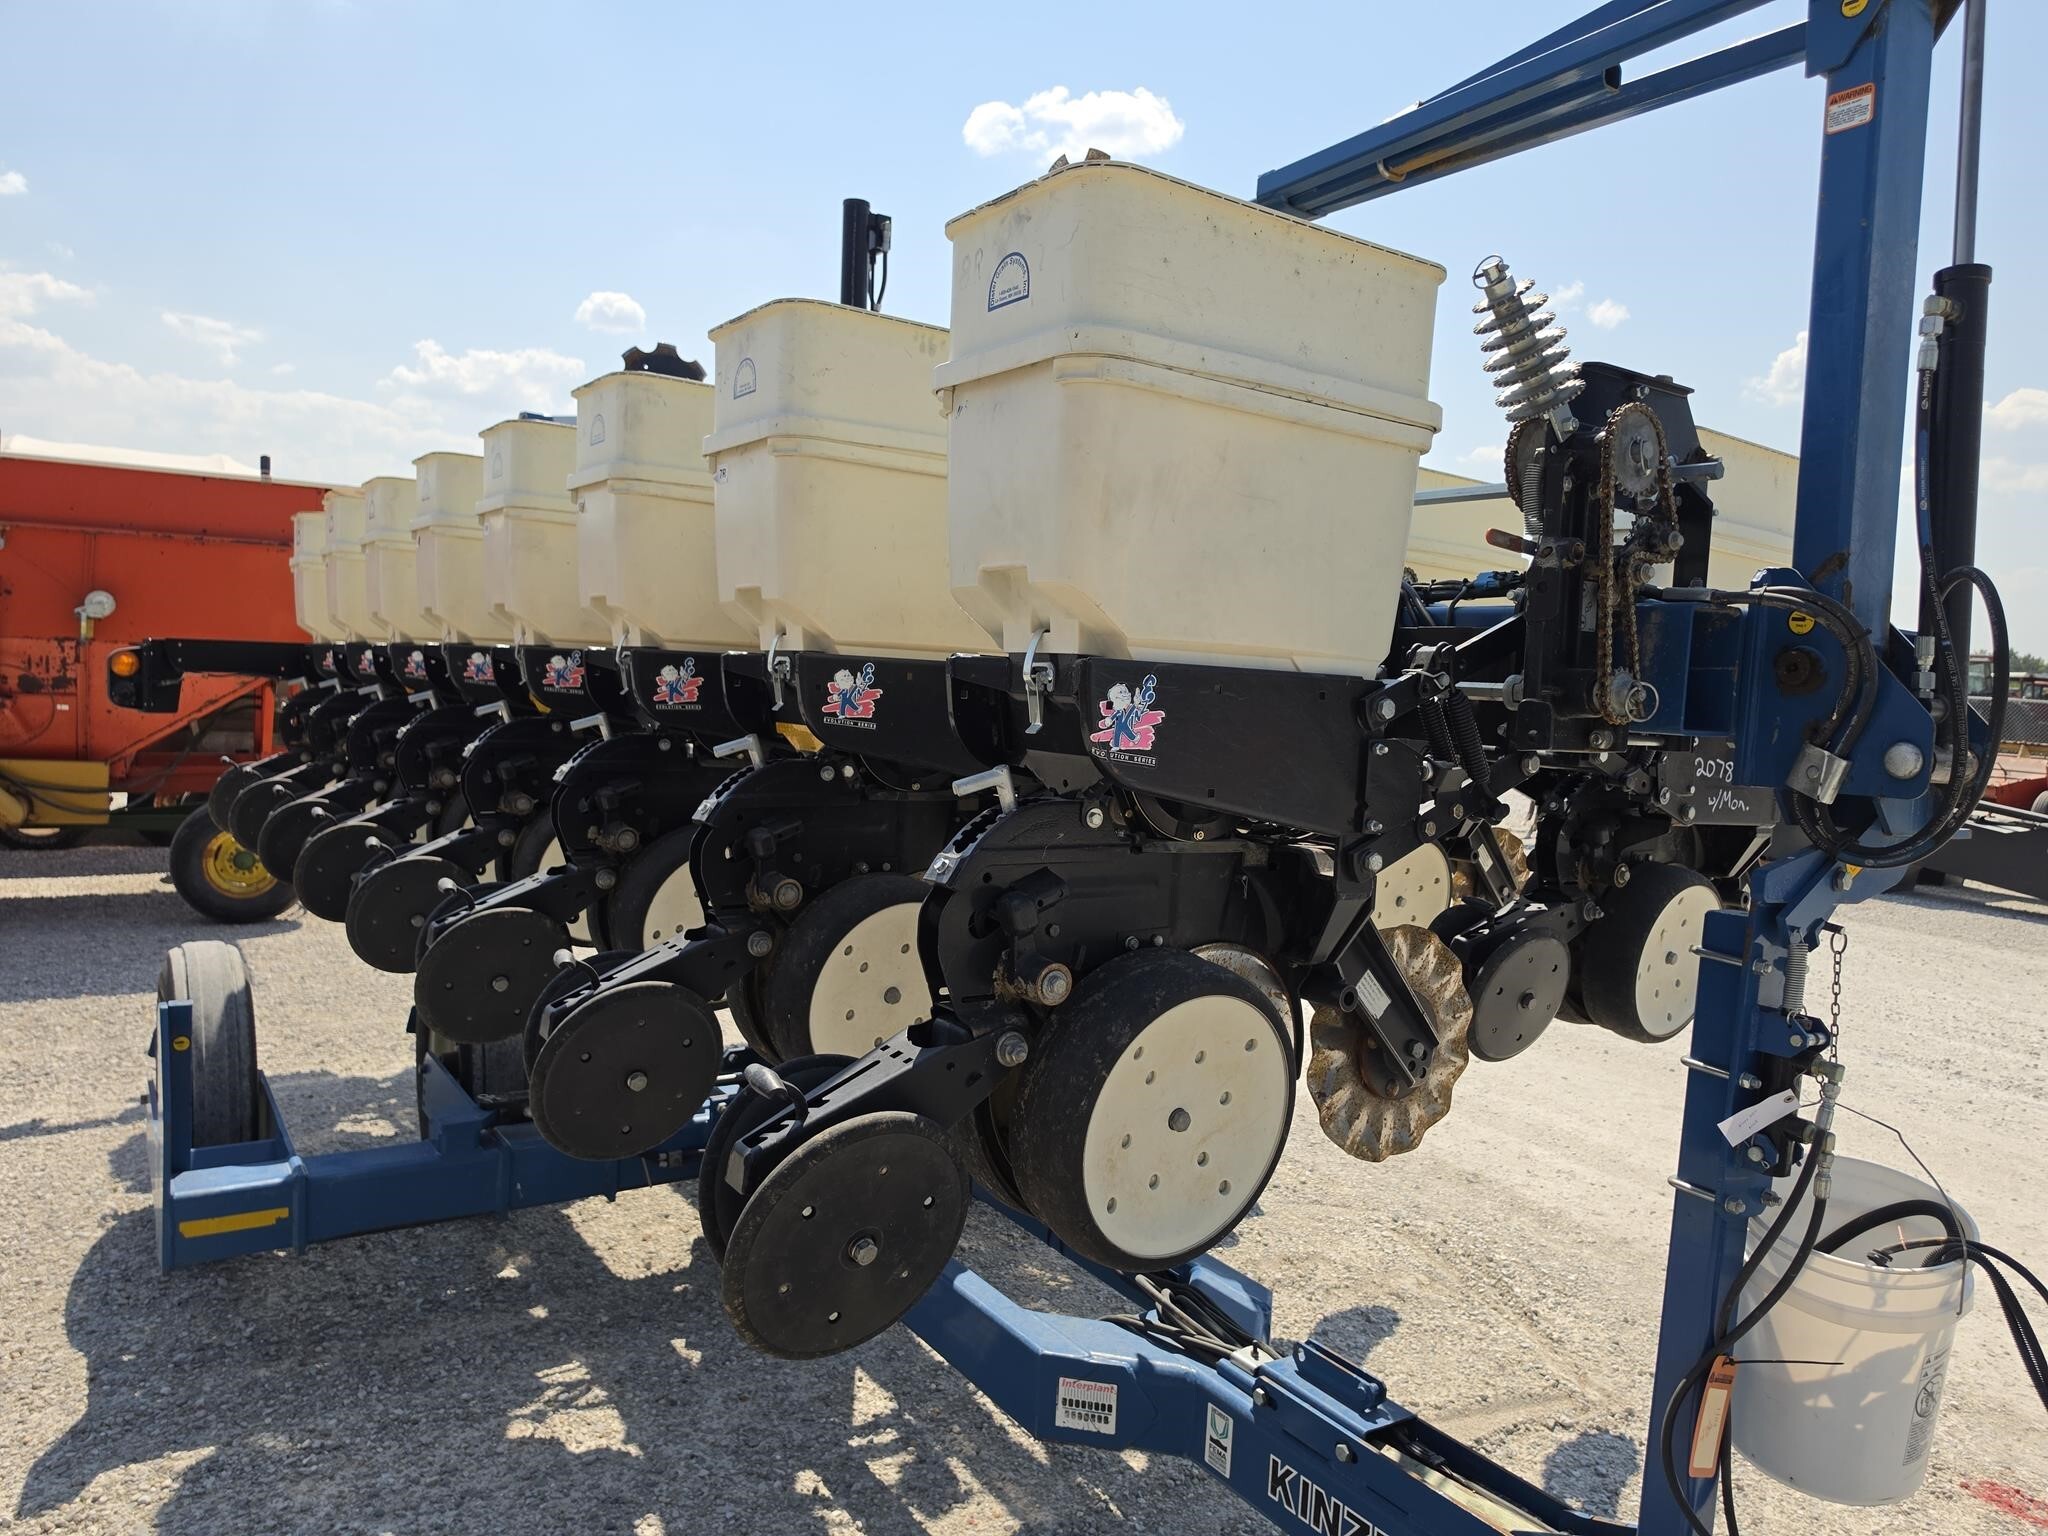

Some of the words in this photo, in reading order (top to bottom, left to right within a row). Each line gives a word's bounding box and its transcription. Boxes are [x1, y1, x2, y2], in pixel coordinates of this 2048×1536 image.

[1838, 84, 1873, 103] WARNING
[1937, 620, 1948, 639] Flame
[1133, 755, 1156, 766] SERIES
[1694, 757, 1734, 783] 2078
[1708, 789, 1750, 813] w/Mon.
[1061, 1378, 1115, 1394] Interplant
[1208, 1443, 1227, 1460] FEMA
